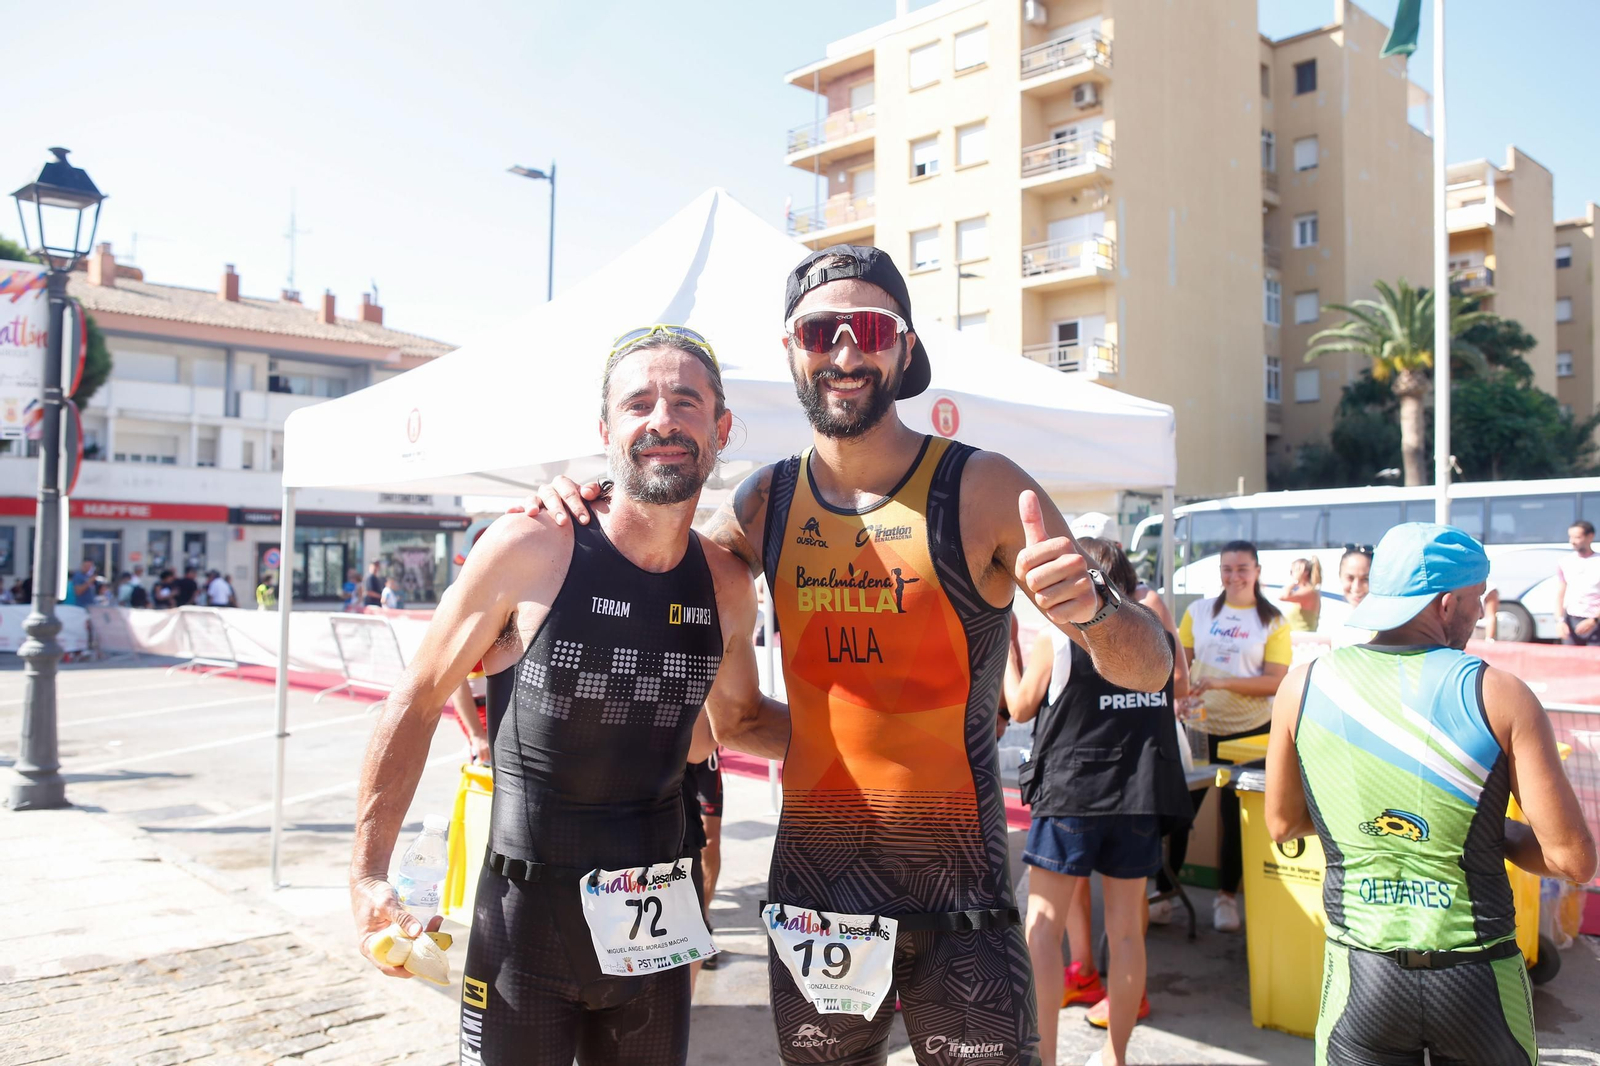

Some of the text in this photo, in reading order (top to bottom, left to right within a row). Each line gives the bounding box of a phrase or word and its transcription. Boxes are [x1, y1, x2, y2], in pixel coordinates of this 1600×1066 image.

[83, 503, 151, 518] MAPFRE
[591, 596, 631, 618] TERRAM
[798, 588, 899, 614] BRILLA
[824, 626, 884, 663] LALA
[1099, 691, 1167, 710] PRENSA
[1359, 878, 1451, 909] OLIVARES
[625, 896, 667, 940] 72
[606, 947, 628, 955] MIGUEL
[669, 937, 689, 946] MACHO
[637, 959, 653, 969] PST
[792, 939, 852, 980] 19
[839, 984, 876, 997] RODRIGUEZ
